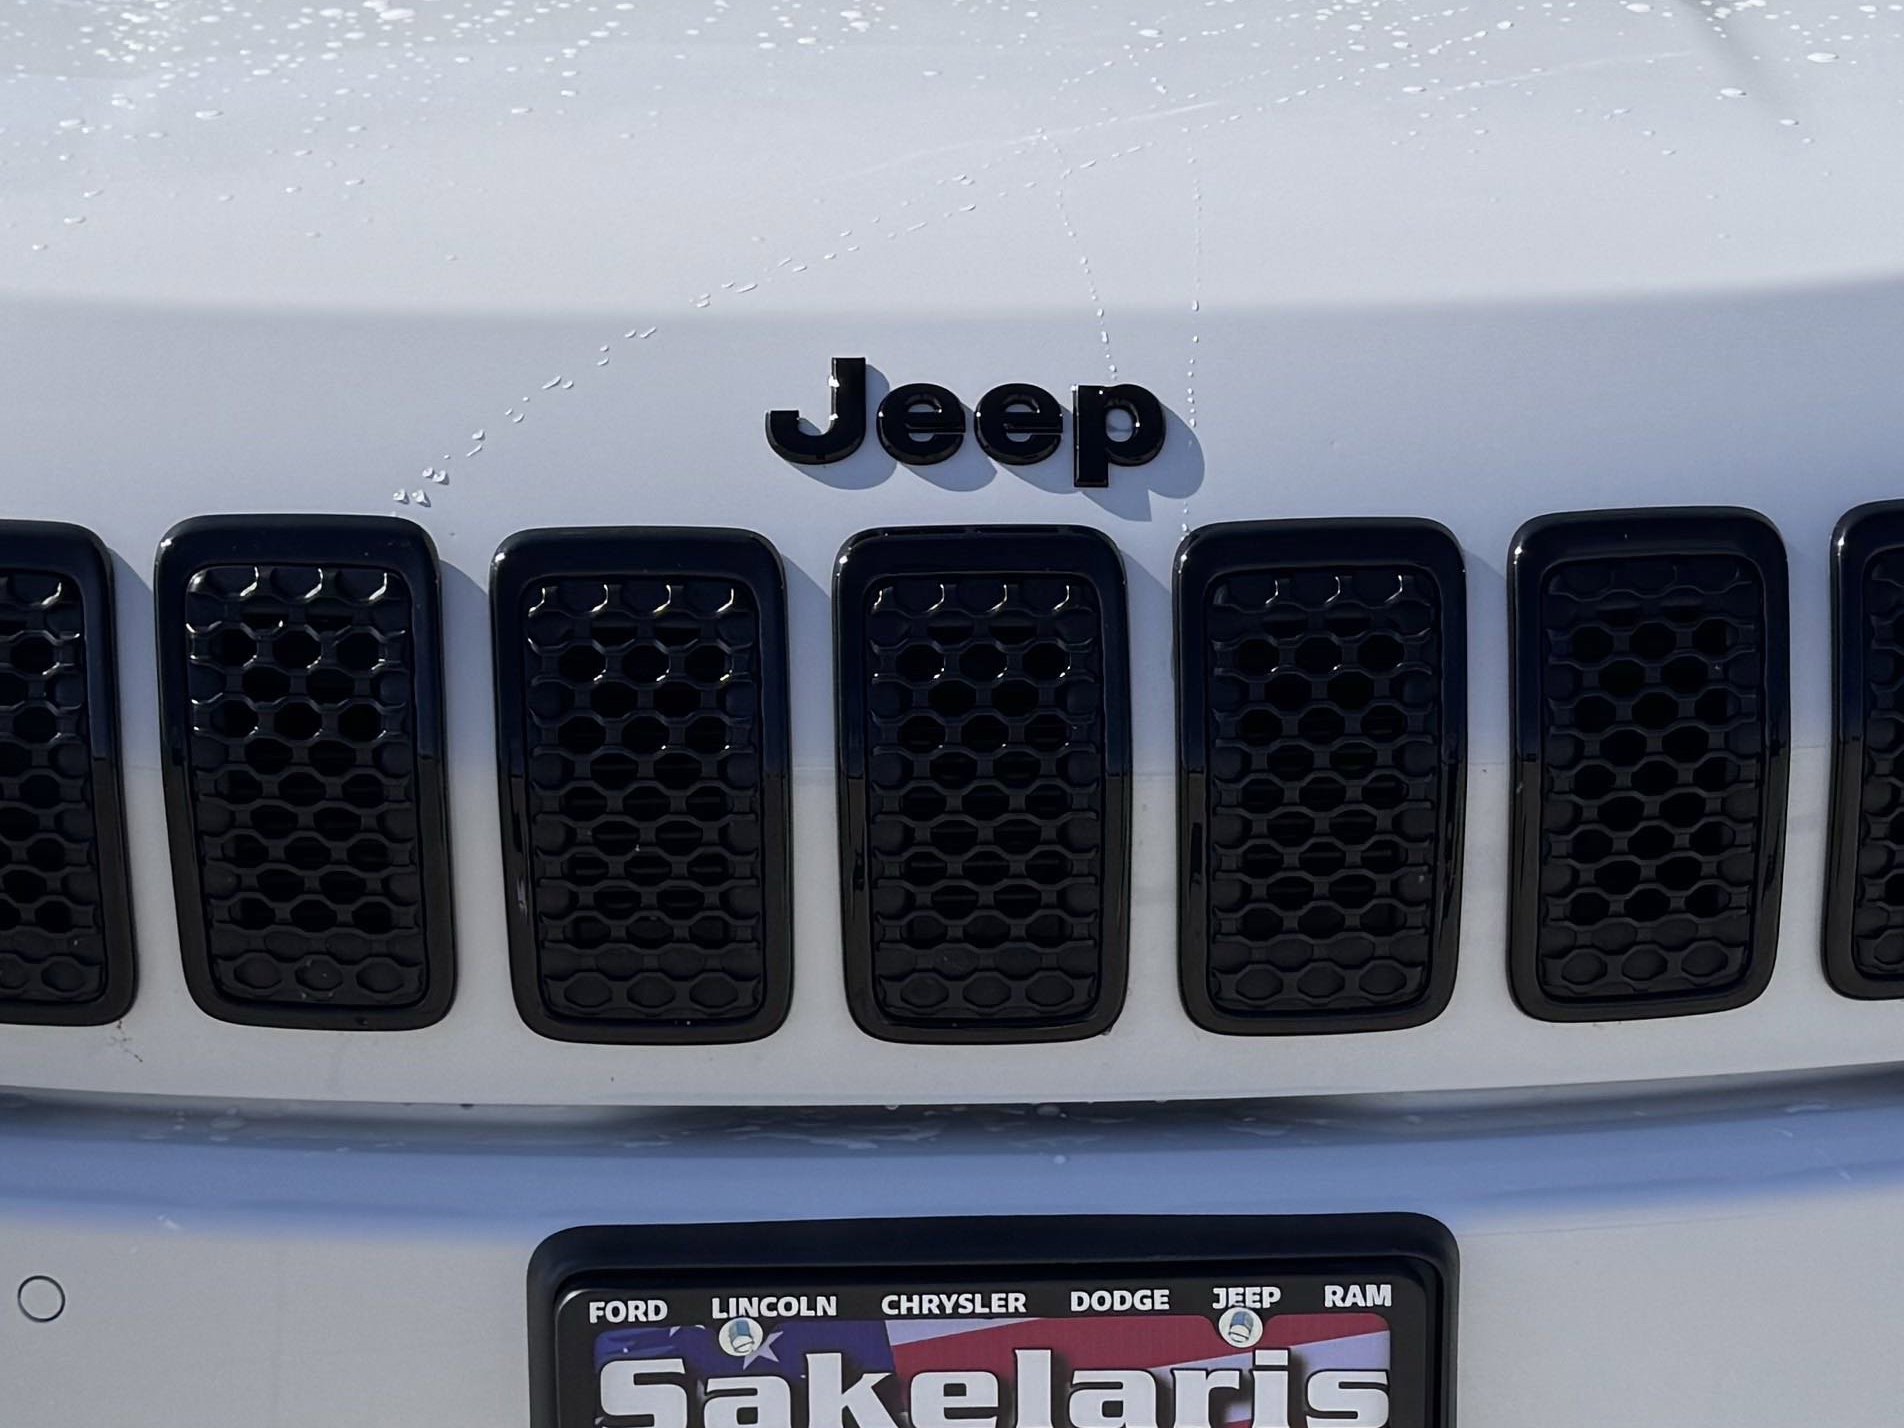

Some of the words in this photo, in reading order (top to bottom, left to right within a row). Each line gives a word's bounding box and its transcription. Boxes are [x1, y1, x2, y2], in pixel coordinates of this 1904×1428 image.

[765, 357, 1166, 488] Jeep
[589, 1299, 668, 1324] FORD
[712, 1296, 837, 1318] LINCOLN
[881, 1292, 1027, 1315] CHRYSLER
[1070, 1289, 1170, 1312] DODGE
[1212, 1286, 1281, 1309] JEEP
[1324, 1284, 1392, 1308] RAM
